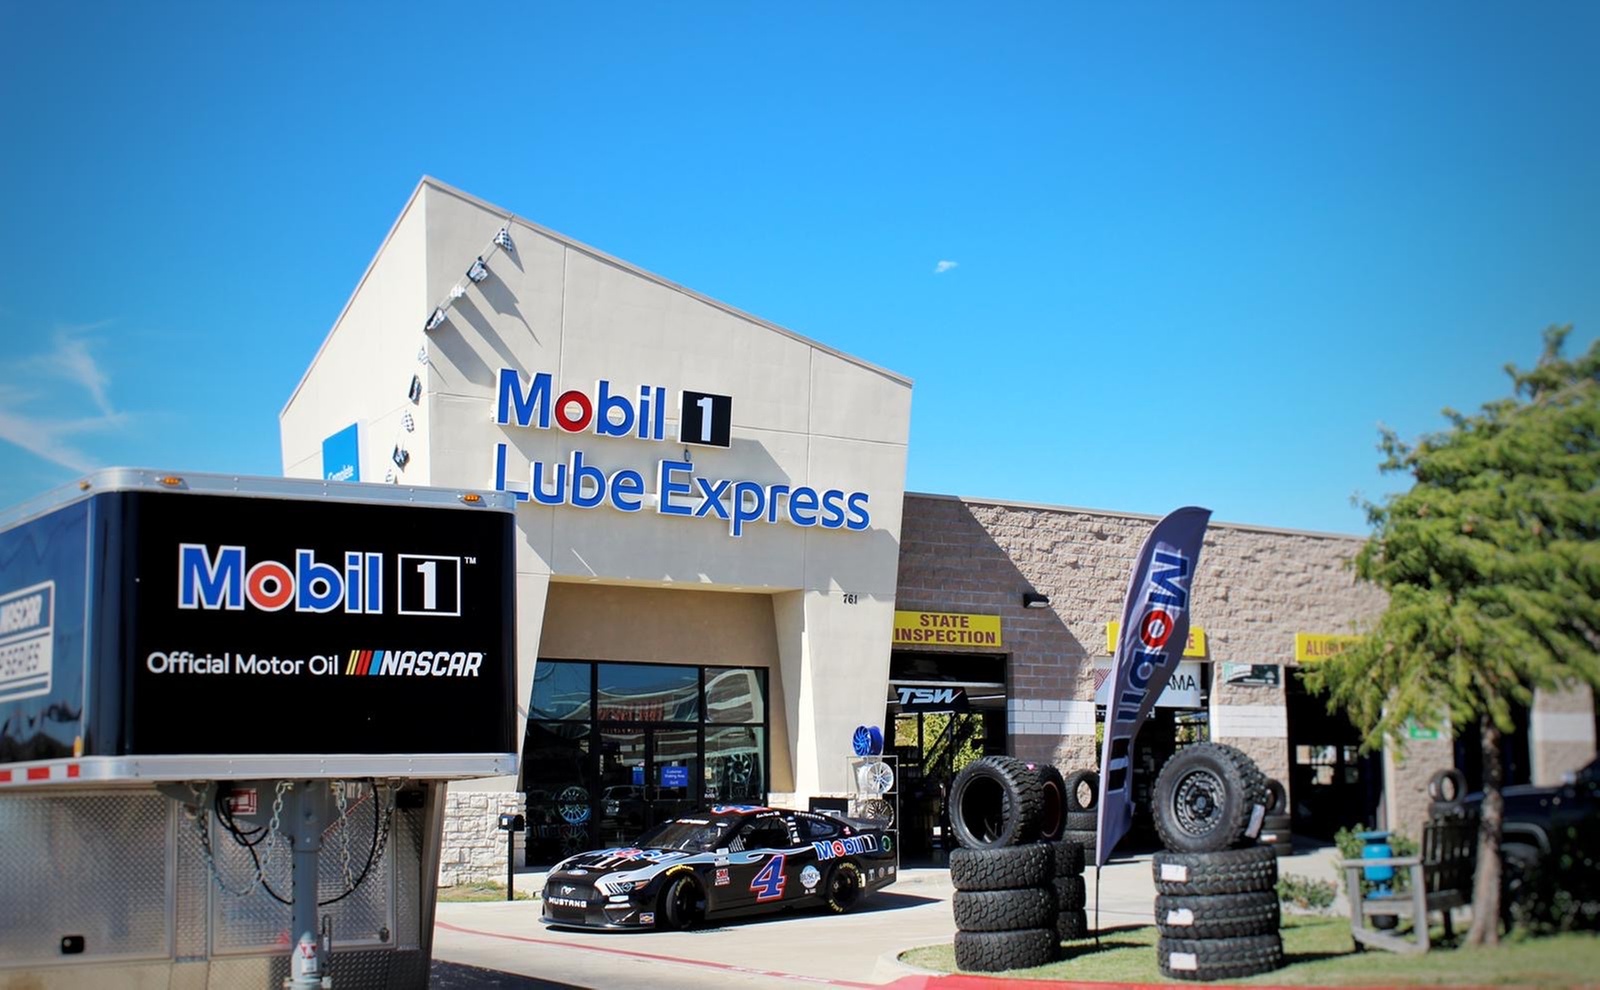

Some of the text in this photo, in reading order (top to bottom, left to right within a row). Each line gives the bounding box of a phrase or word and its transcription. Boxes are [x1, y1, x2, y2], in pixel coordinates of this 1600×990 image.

[496, 368, 666, 441] Mobil
[495, 442, 870, 537] Lube Express
[178, 543, 383, 614] Mobil
[842, 594, 858, 605] 761
[919, 613, 969, 628] STATE
[895, 628, 996, 644] INSPECTION
[1115, 549, 1191, 723] Mobil
[147, 650, 484, 677] Official Motor Oil NASCAR
[898, 687, 962, 704] TSW
[812, 836, 863, 861] Mobil
[750, 853, 789, 903] 4
[548, 897, 587, 908] MUSTANG
